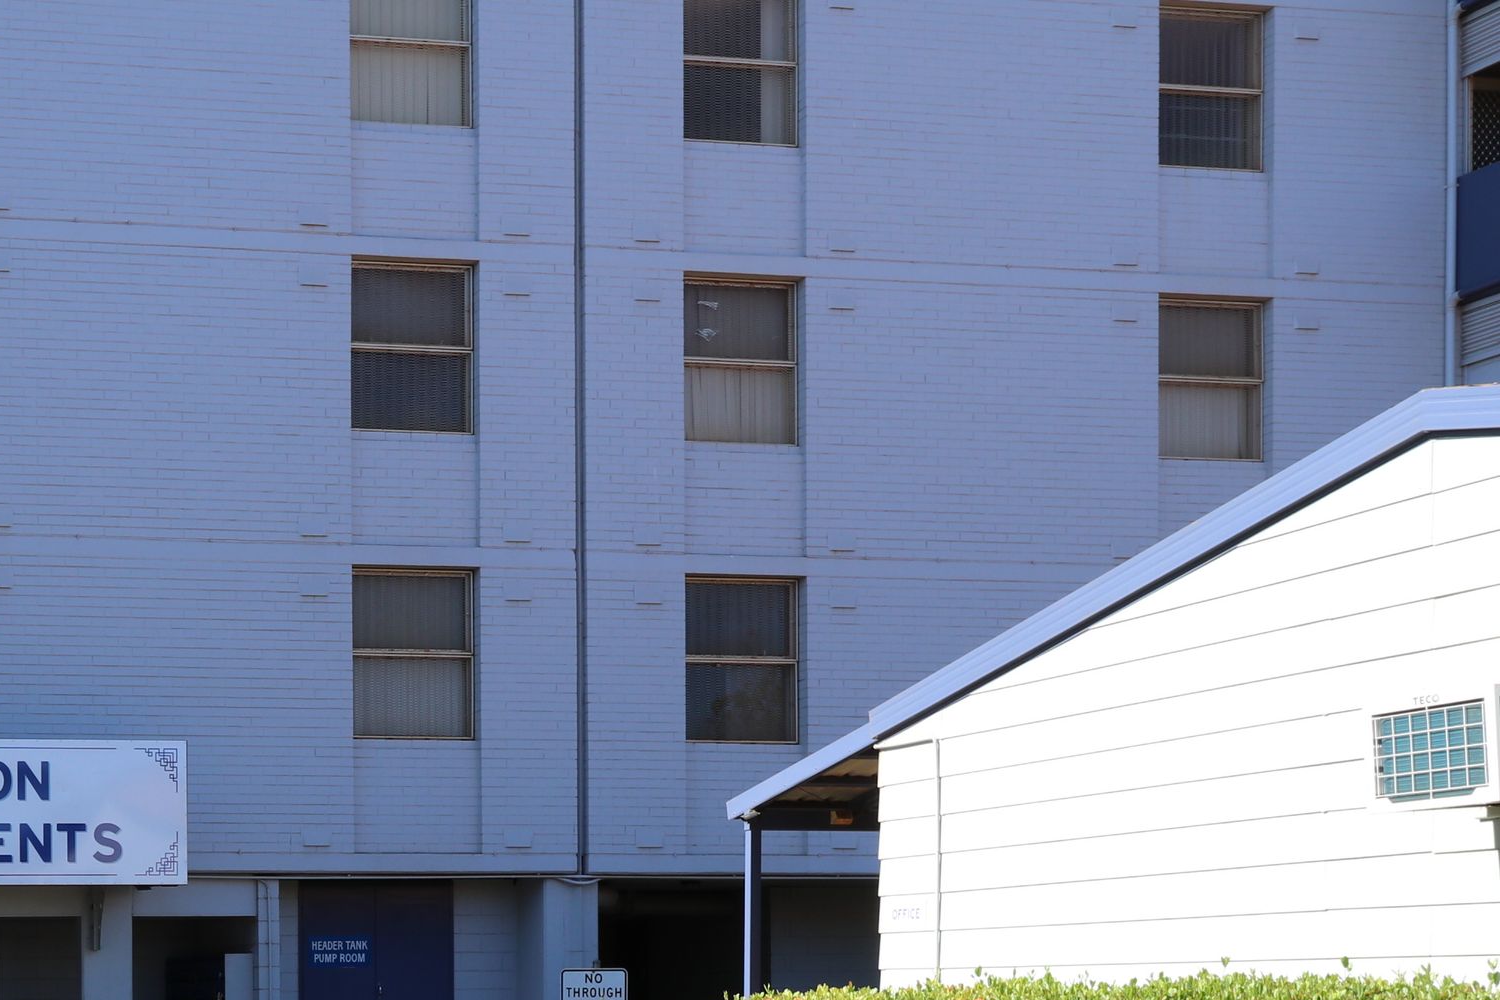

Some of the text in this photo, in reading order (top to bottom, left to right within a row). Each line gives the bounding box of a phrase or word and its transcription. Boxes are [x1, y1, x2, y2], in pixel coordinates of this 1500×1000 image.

[1412, 693, 1441, 705] TECO
[891, 907, 921, 921] OFFICE
[311, 940, 368, 951] HEADER TANK
[313, 953, 366, 963] PUMP ROOM
[584, 973, 603, 984] NO
[566, 986, 622, 998] THROUGH
